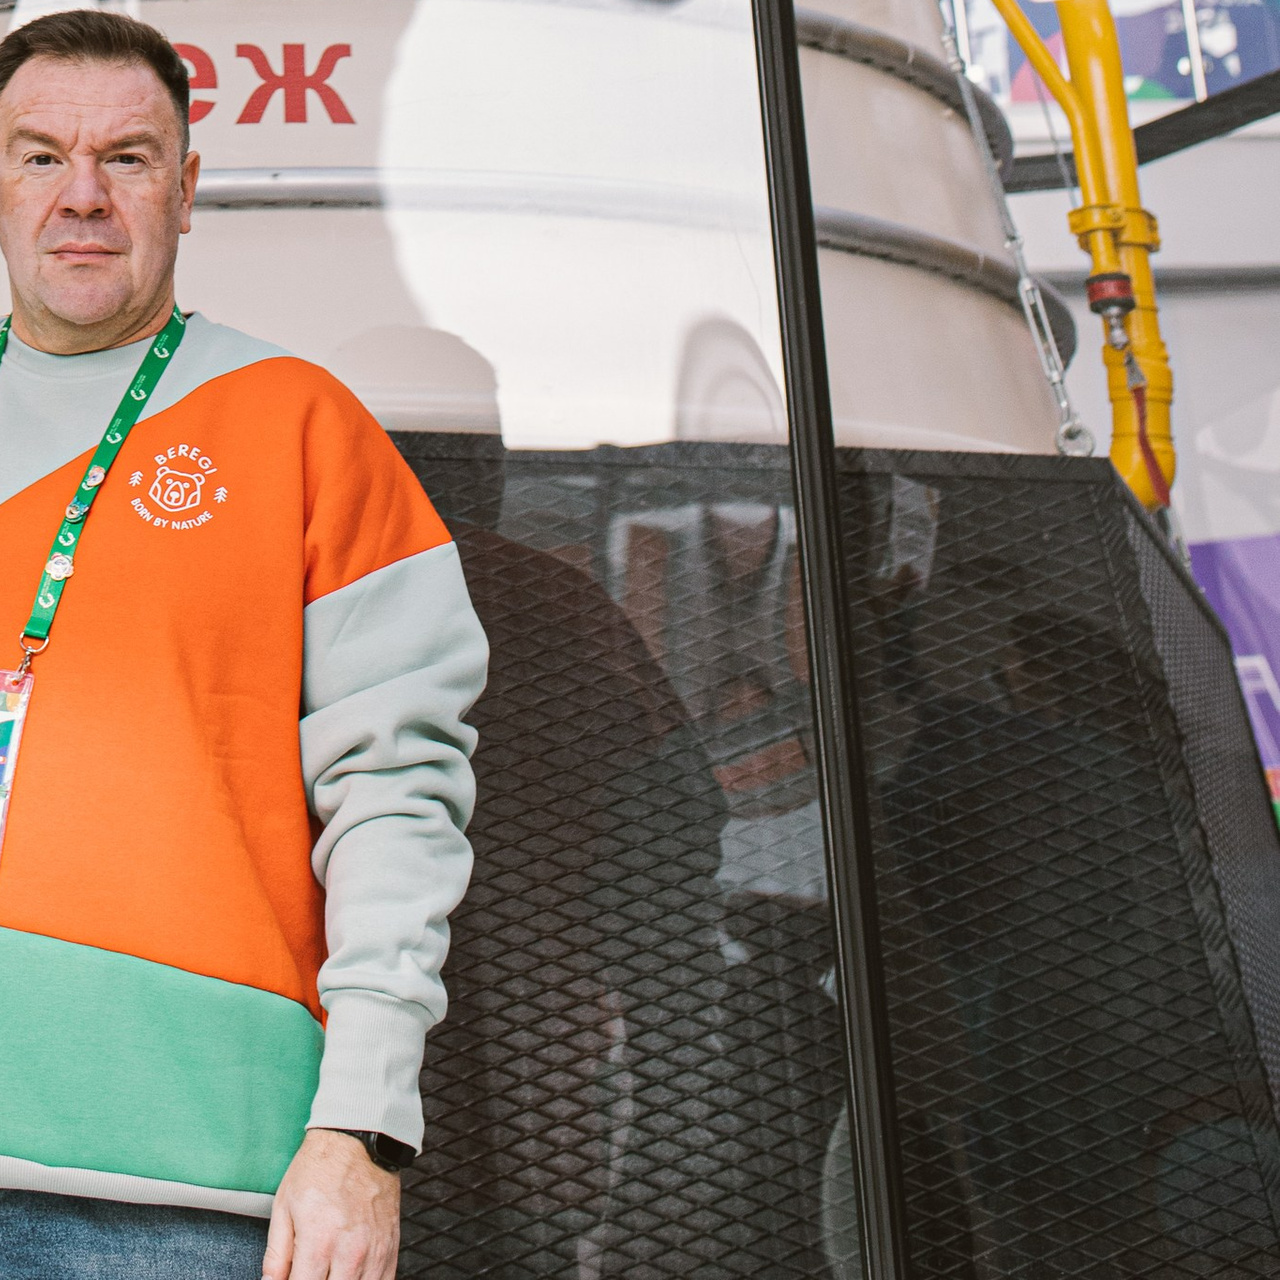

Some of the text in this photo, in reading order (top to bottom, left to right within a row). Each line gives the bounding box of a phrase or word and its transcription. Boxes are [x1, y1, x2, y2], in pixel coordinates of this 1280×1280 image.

[154, 444, 218, 474] BEREGI
[130, 497, 214, 530] BORN BY NATURE
